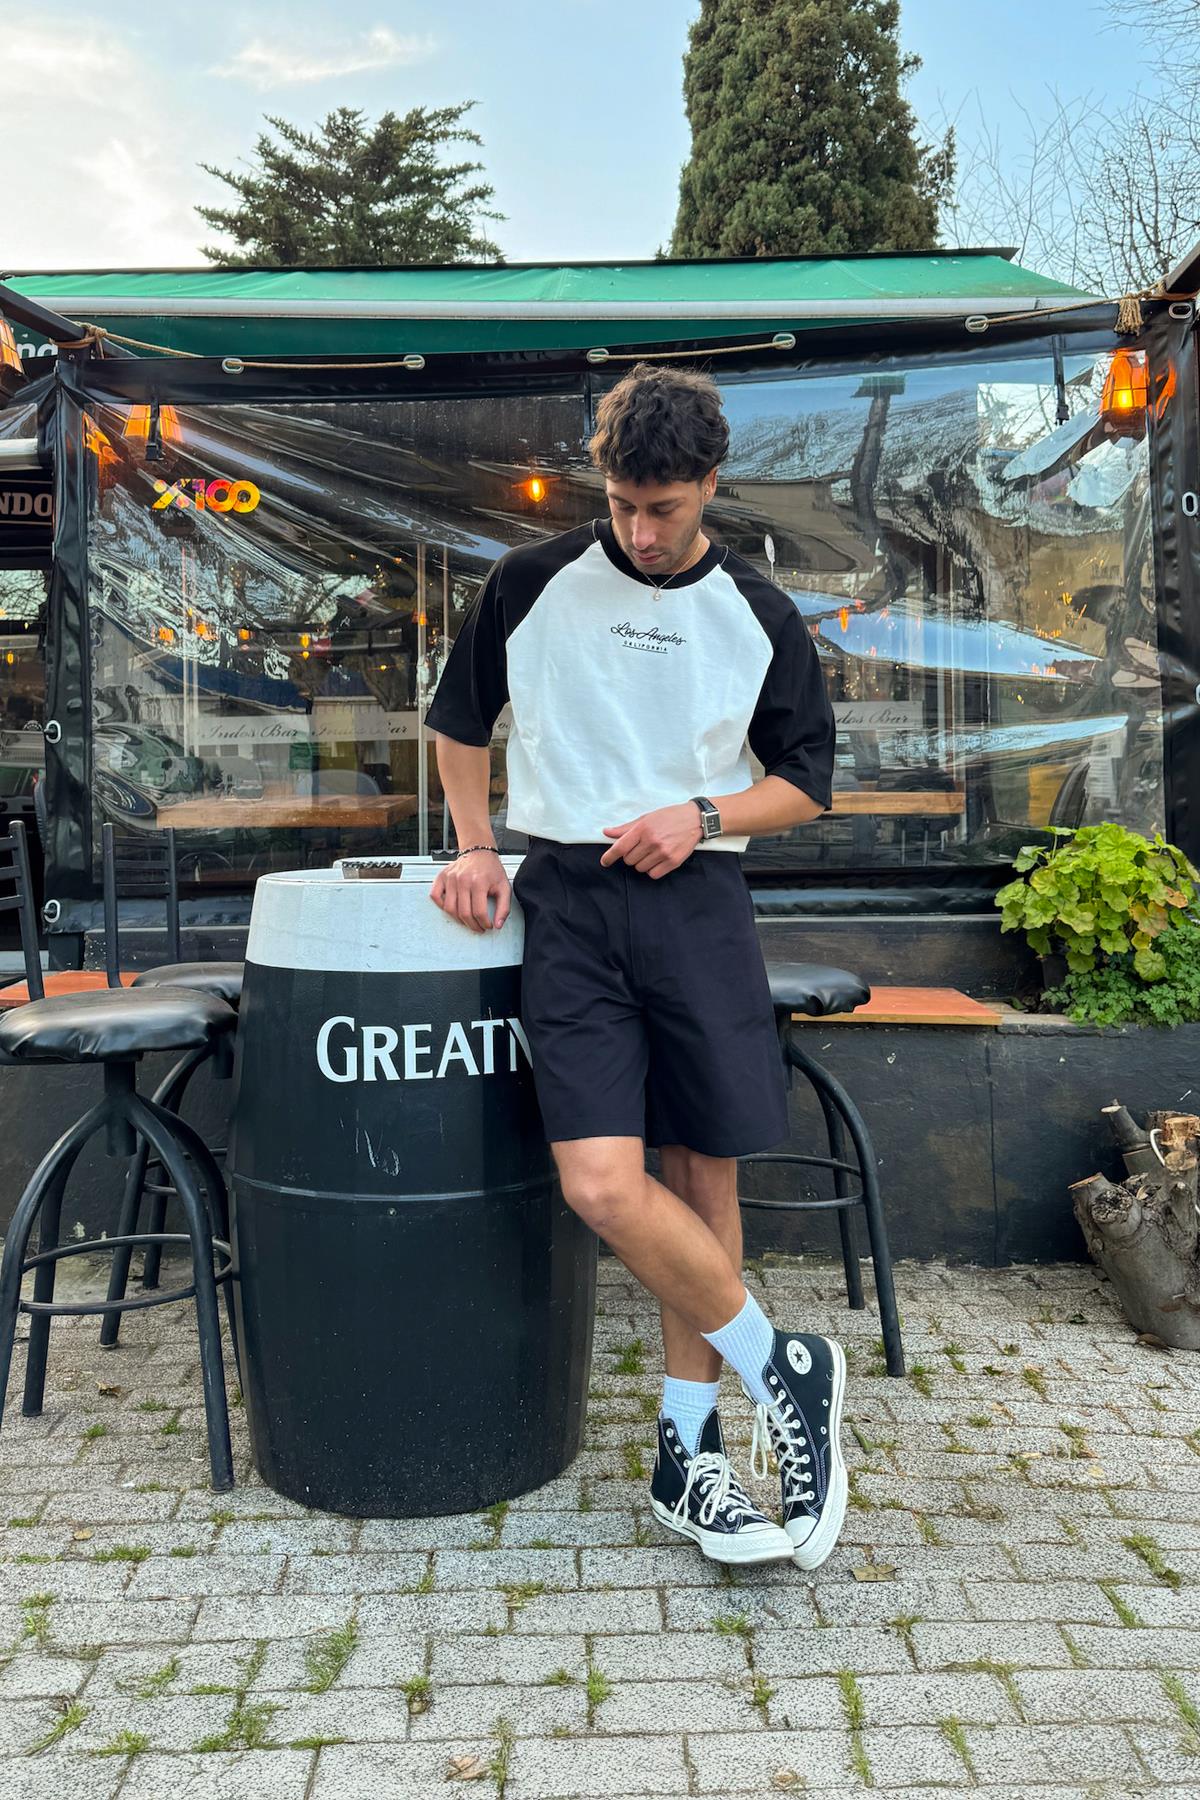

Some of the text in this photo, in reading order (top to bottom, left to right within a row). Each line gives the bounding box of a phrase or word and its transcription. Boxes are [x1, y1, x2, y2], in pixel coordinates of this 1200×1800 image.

[610, 622, 687, 646] Los Angeles
[624, 640, 667, 652] CALIFORNIA
[260, 722, 299, 737] Bar
